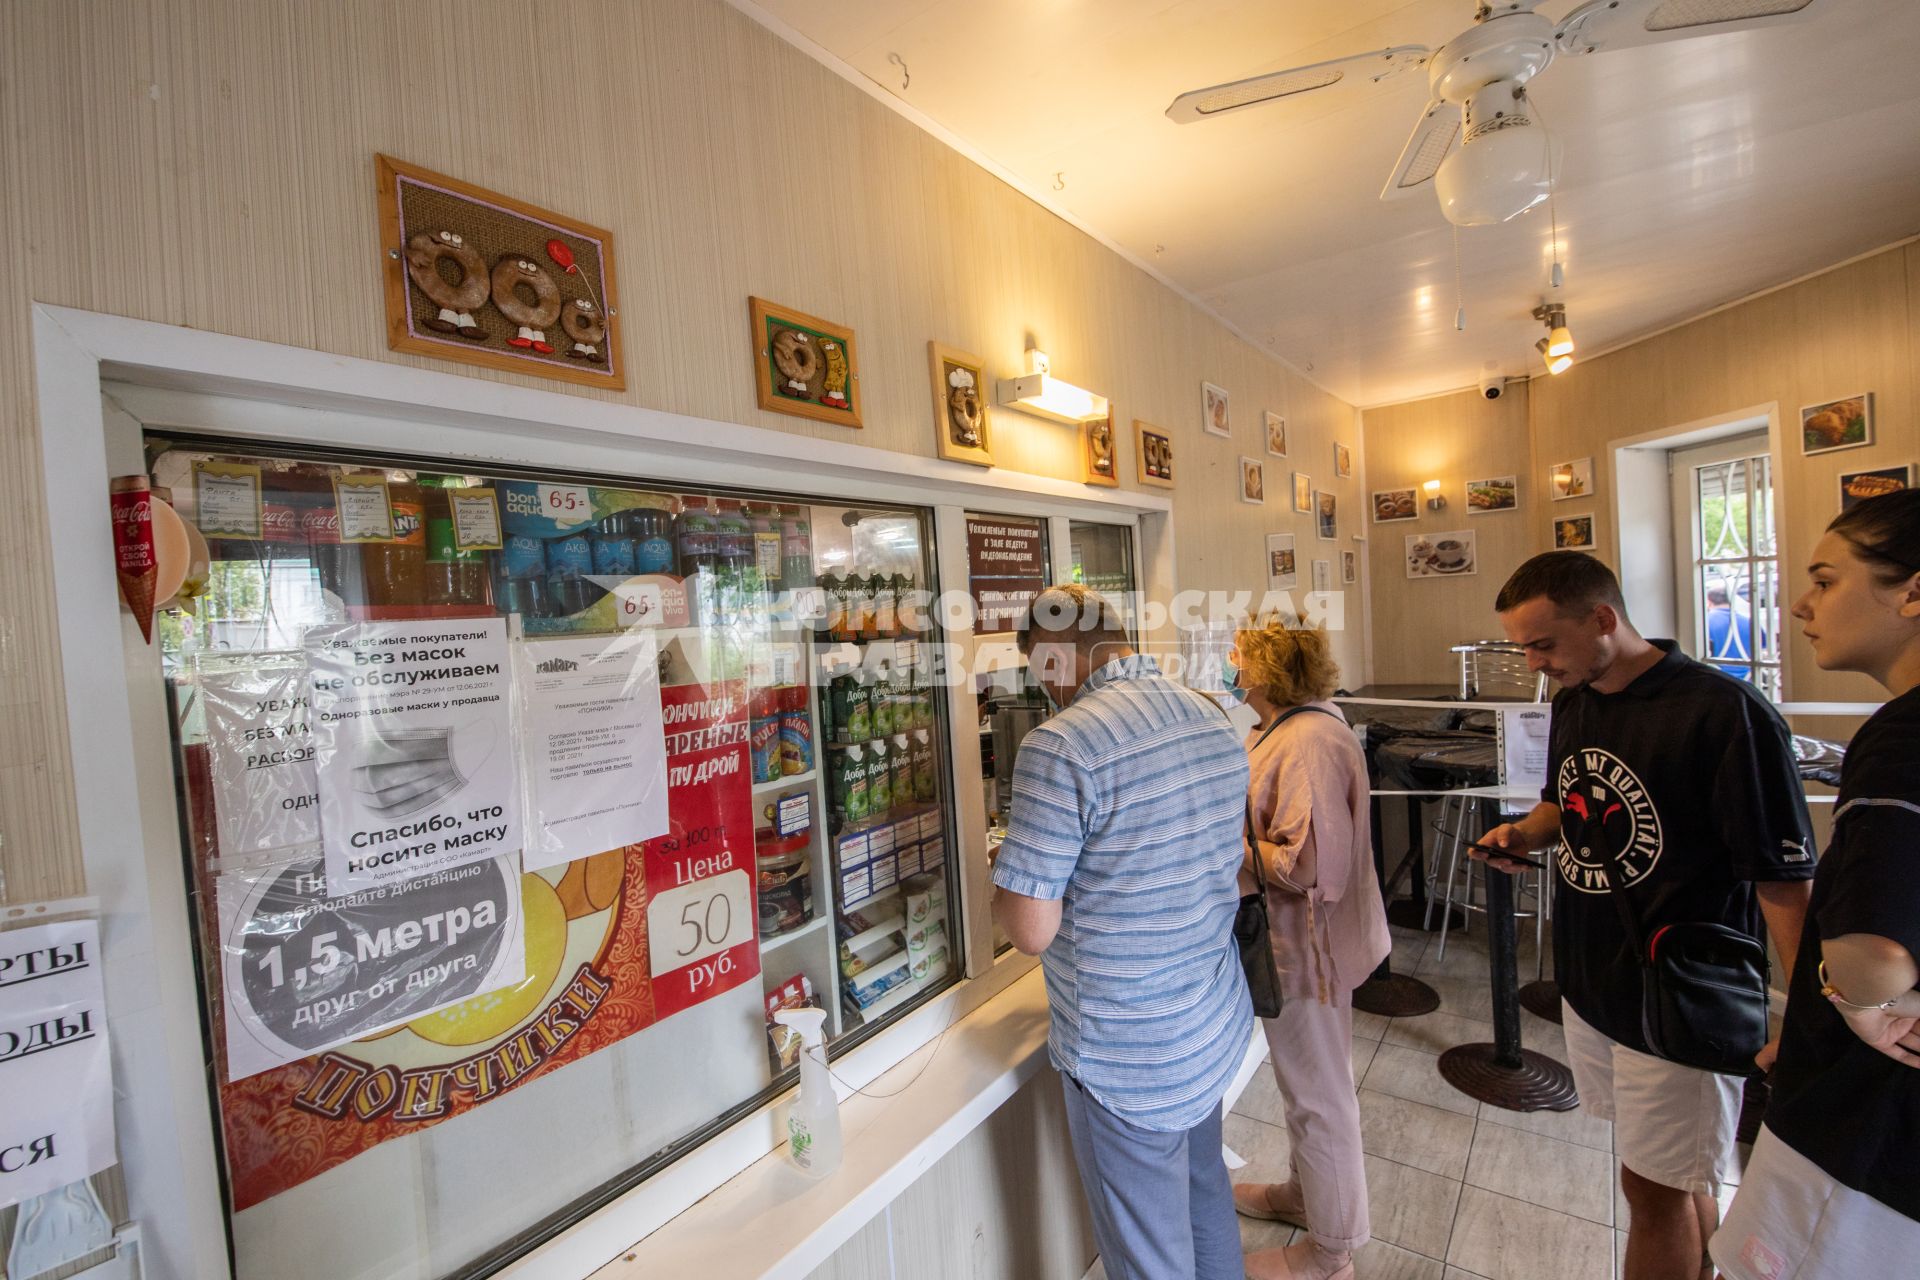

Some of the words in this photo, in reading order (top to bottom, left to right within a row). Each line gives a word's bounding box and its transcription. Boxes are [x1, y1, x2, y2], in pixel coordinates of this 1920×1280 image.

[507, 489, 541, 503] bon
[393, 516, 420, 530] ANTA
[119, 541, 150, 552] ОТКРОЙ
[120, 559, 152, 568] VANILLA
[660, 588, 683, 597] on-
[662, 597, 685, 607] qua
[989, 607, 1027, 620] ПРИНИМА
[410, 630, 487, 646] покупатели!
[354, 651, 395, 666] Без
[402, 647, 466, 663] масок
[315, 677, 344, 691] не
[352, 663, 500, 688] обслуживаем
[457, 681, 490, 692] 12.06.2021
[256, 697, 311, 713] УВАЖ
[320, 704, 405, 722] Одноразовые
[407, 700, 440, 712] маски
[442, 700, 449, 710] у
[451, 693, 500, 708] продавца
[244, 726, 275, 742] БЕЗ
[281, 722, 313, 737] МА
[665, 722, 749, 756] АРЕНЫЕ
[752, 721, 779, 747] PULPY
[583, 767, 604, 777] только
[669, 749, 740, 788] ПУДРОЙ
[350, 814, 462, 849] Спасибо,
[467, 805, 503, 822] что
[544, 813, 587, 827] Аминистрация
[348, 842, 437, 873] носите
[444, 824, 508, 851] маску
[373, 860, 439, 880] Администрация
[439, 854, 459, 866] ООО
[674, 850, 733, 885] Цена
[391, 864, 482, 898] дистанцию
[677, 893, 731, 957] 50
[259, 931, 341, 990] 1,5
[356, 899, 498, 964] метра
[0, 941, 88, 981] РТЫ
[687, 949, 737, 993] руб.
[291, 991, 360, 1030] друг
[368, 977, 399, 1000] от
[405, 951, 478, 993] друга
[0, 1009, 93, 1057] ОДЫ
[296, 968, 609, 1120] ПОНЧИКИ
[0, 1133, 57, 1173] СЯ
